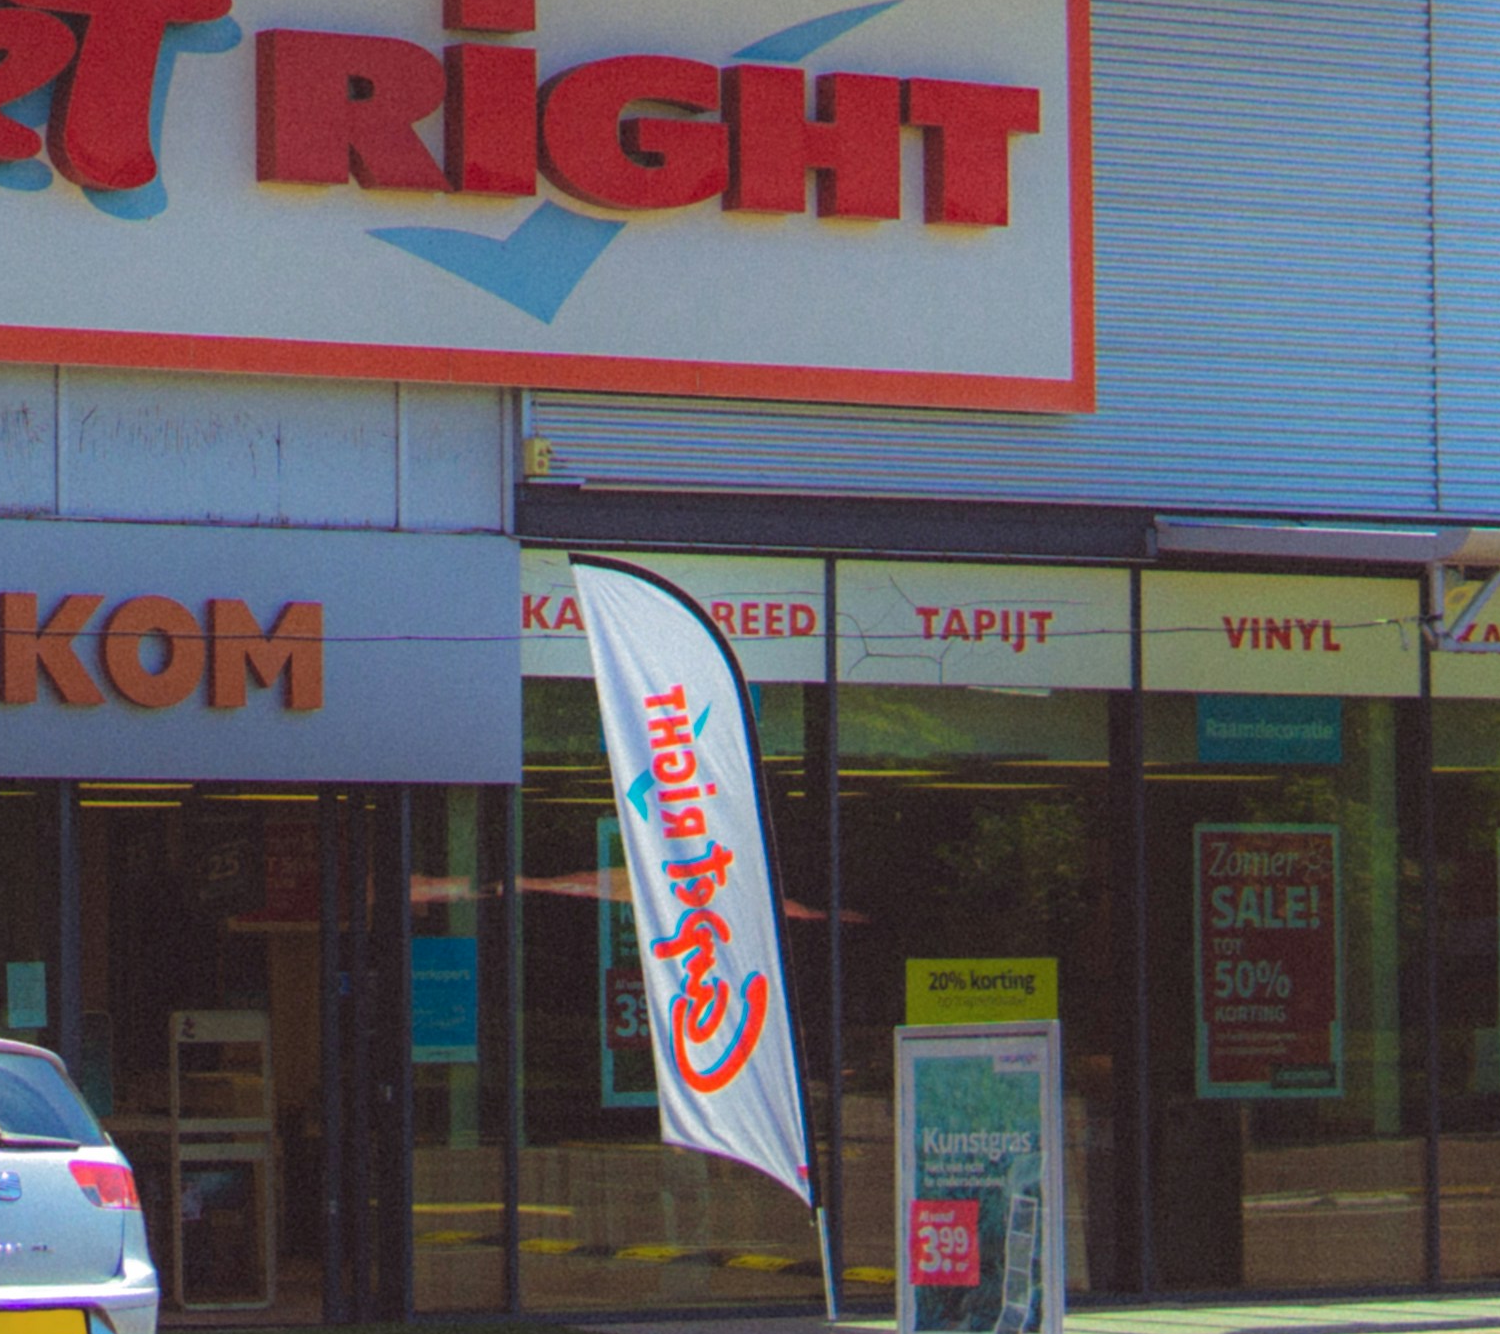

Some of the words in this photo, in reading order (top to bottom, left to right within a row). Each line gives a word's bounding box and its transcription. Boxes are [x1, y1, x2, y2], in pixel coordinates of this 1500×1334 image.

[915, 607, 1053, 653] TAPIJT
[1222, 616, 1341, 652] VINYL
[1205, 719, 1333, 741] Raamdecoratie
[1209, 842, 1299, 877] Zomer
[1211, 885, 1320, 930] SALE!
[1212, 938, 1243, 955] TOT
[929, 971, 966, 991] 20%
[970, 969, 1035, 994] korting
[1214, 960, 1291, 998] 50%
[1214, 1004, 1286, 1023] KORTING
[923, 1128, 1031, 1161] Kunstgras
[918, 1225, 969, 1274] 3.99
